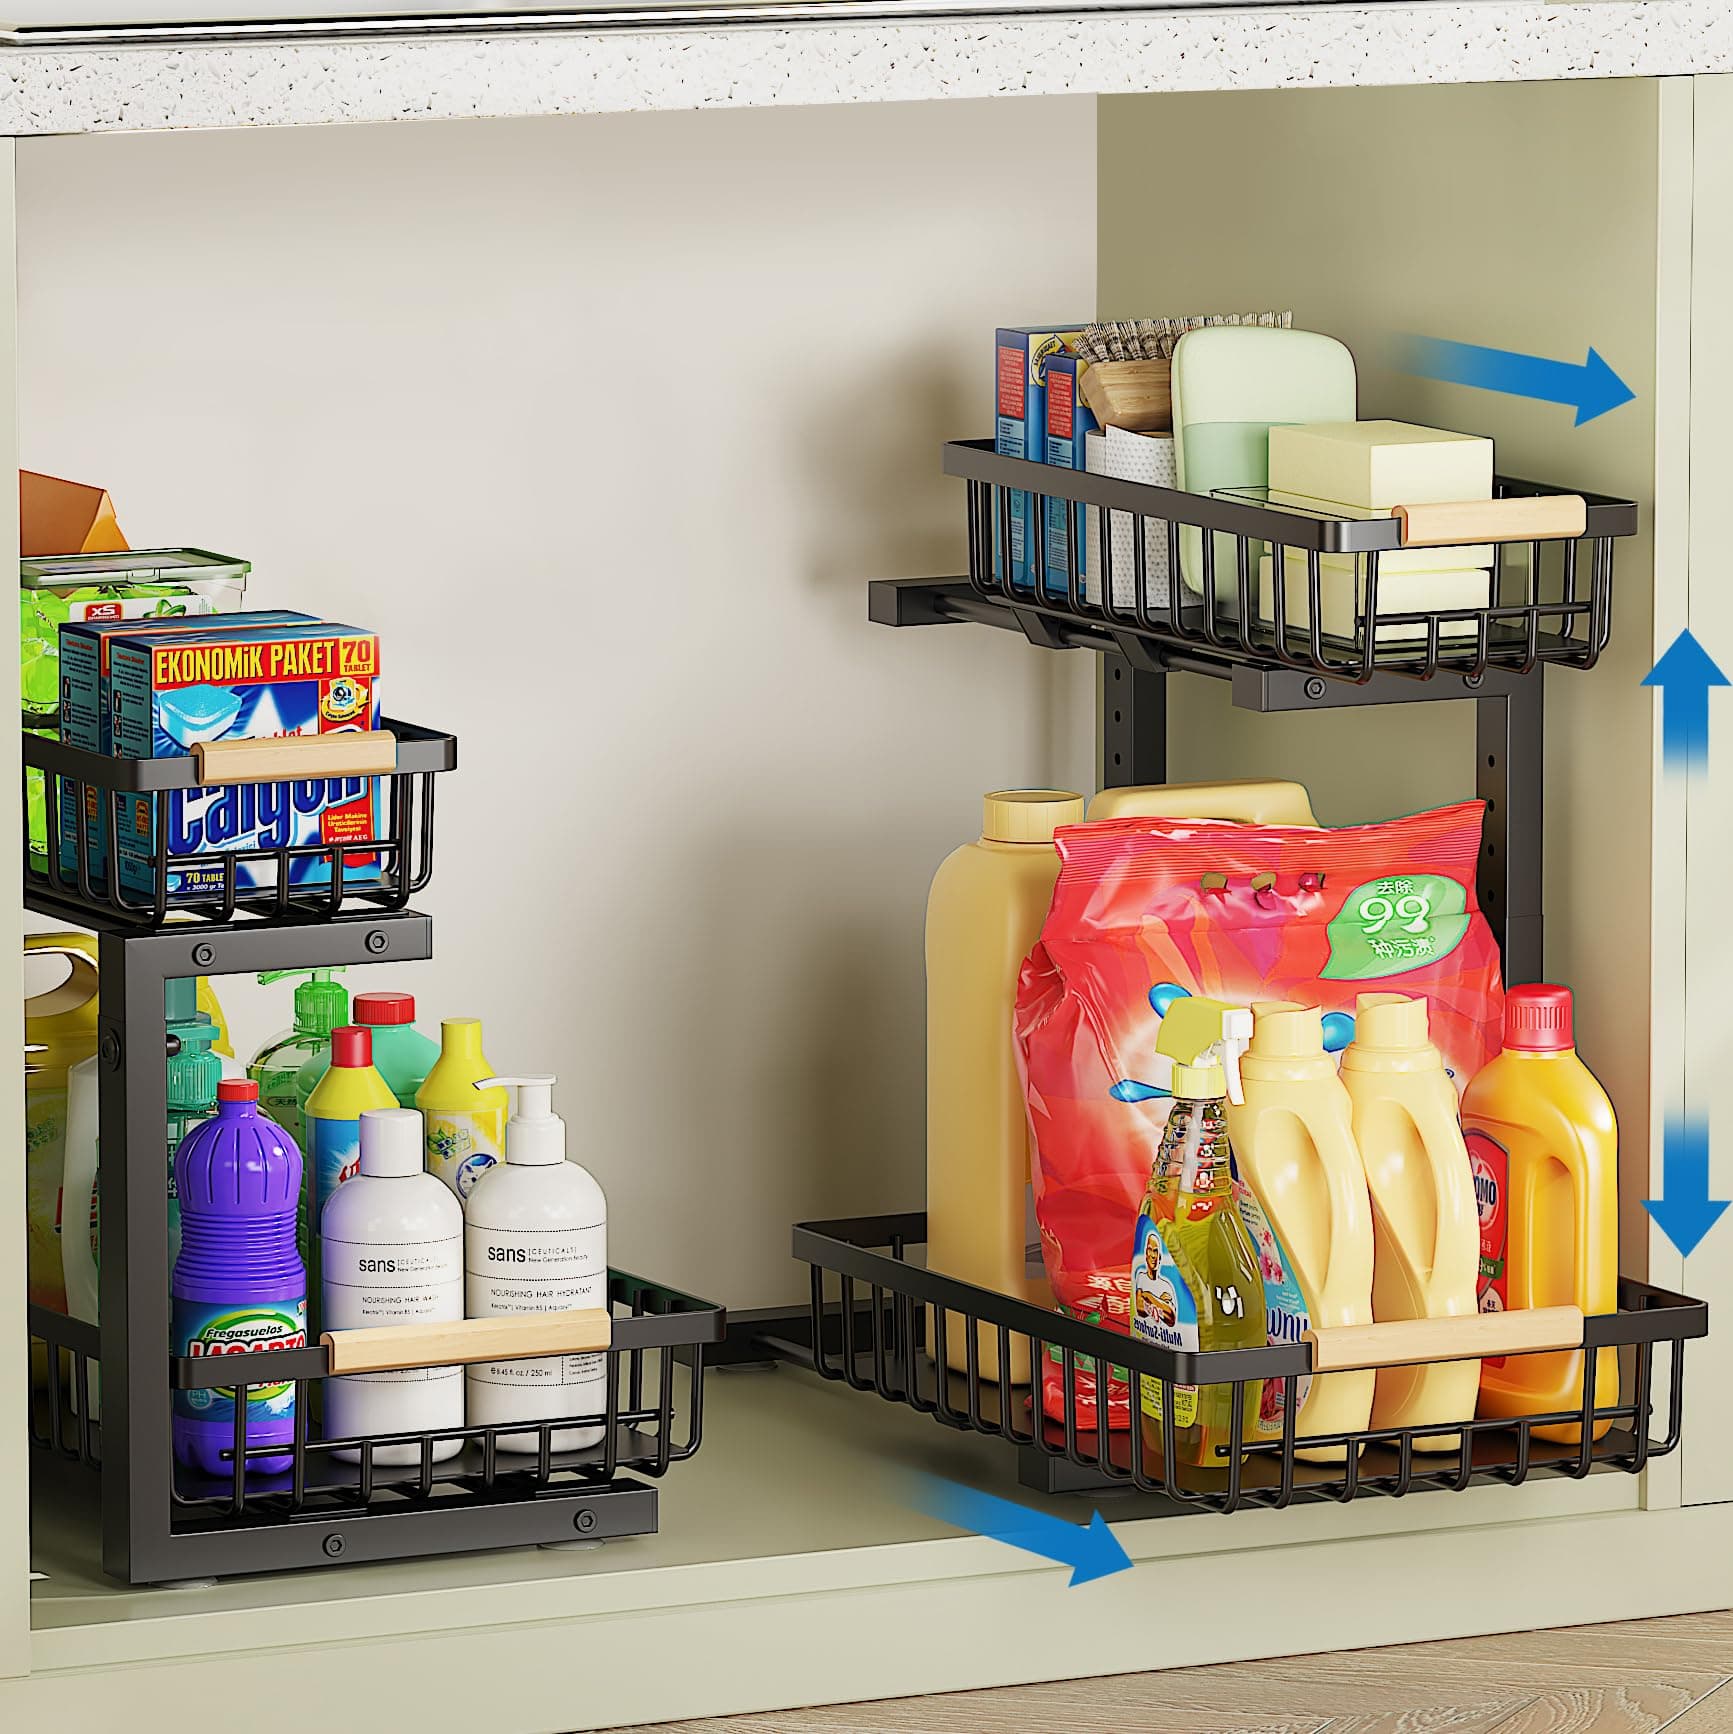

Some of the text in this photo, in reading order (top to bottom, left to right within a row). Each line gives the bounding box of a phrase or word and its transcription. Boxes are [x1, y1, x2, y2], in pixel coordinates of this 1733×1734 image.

[271, 641, 335, 677] PAKET
[342, 640, 371, 664] 70
[343, 663, 372, 673] TABLET
[186, 872, 225, 884] 70 TABLE
[1376, 880, 1415, 895] 去除
[1359, 895, 1431, 935] 99
[487, 1246, 526, 1263] sans
[359, 1258, 396, 1273] sans
[490, 1288, 533, 1299] NOURISHING
[536, 1290, 554, 1298] HAIR
[205, 1325, 283, 1339] Fregasuelos
